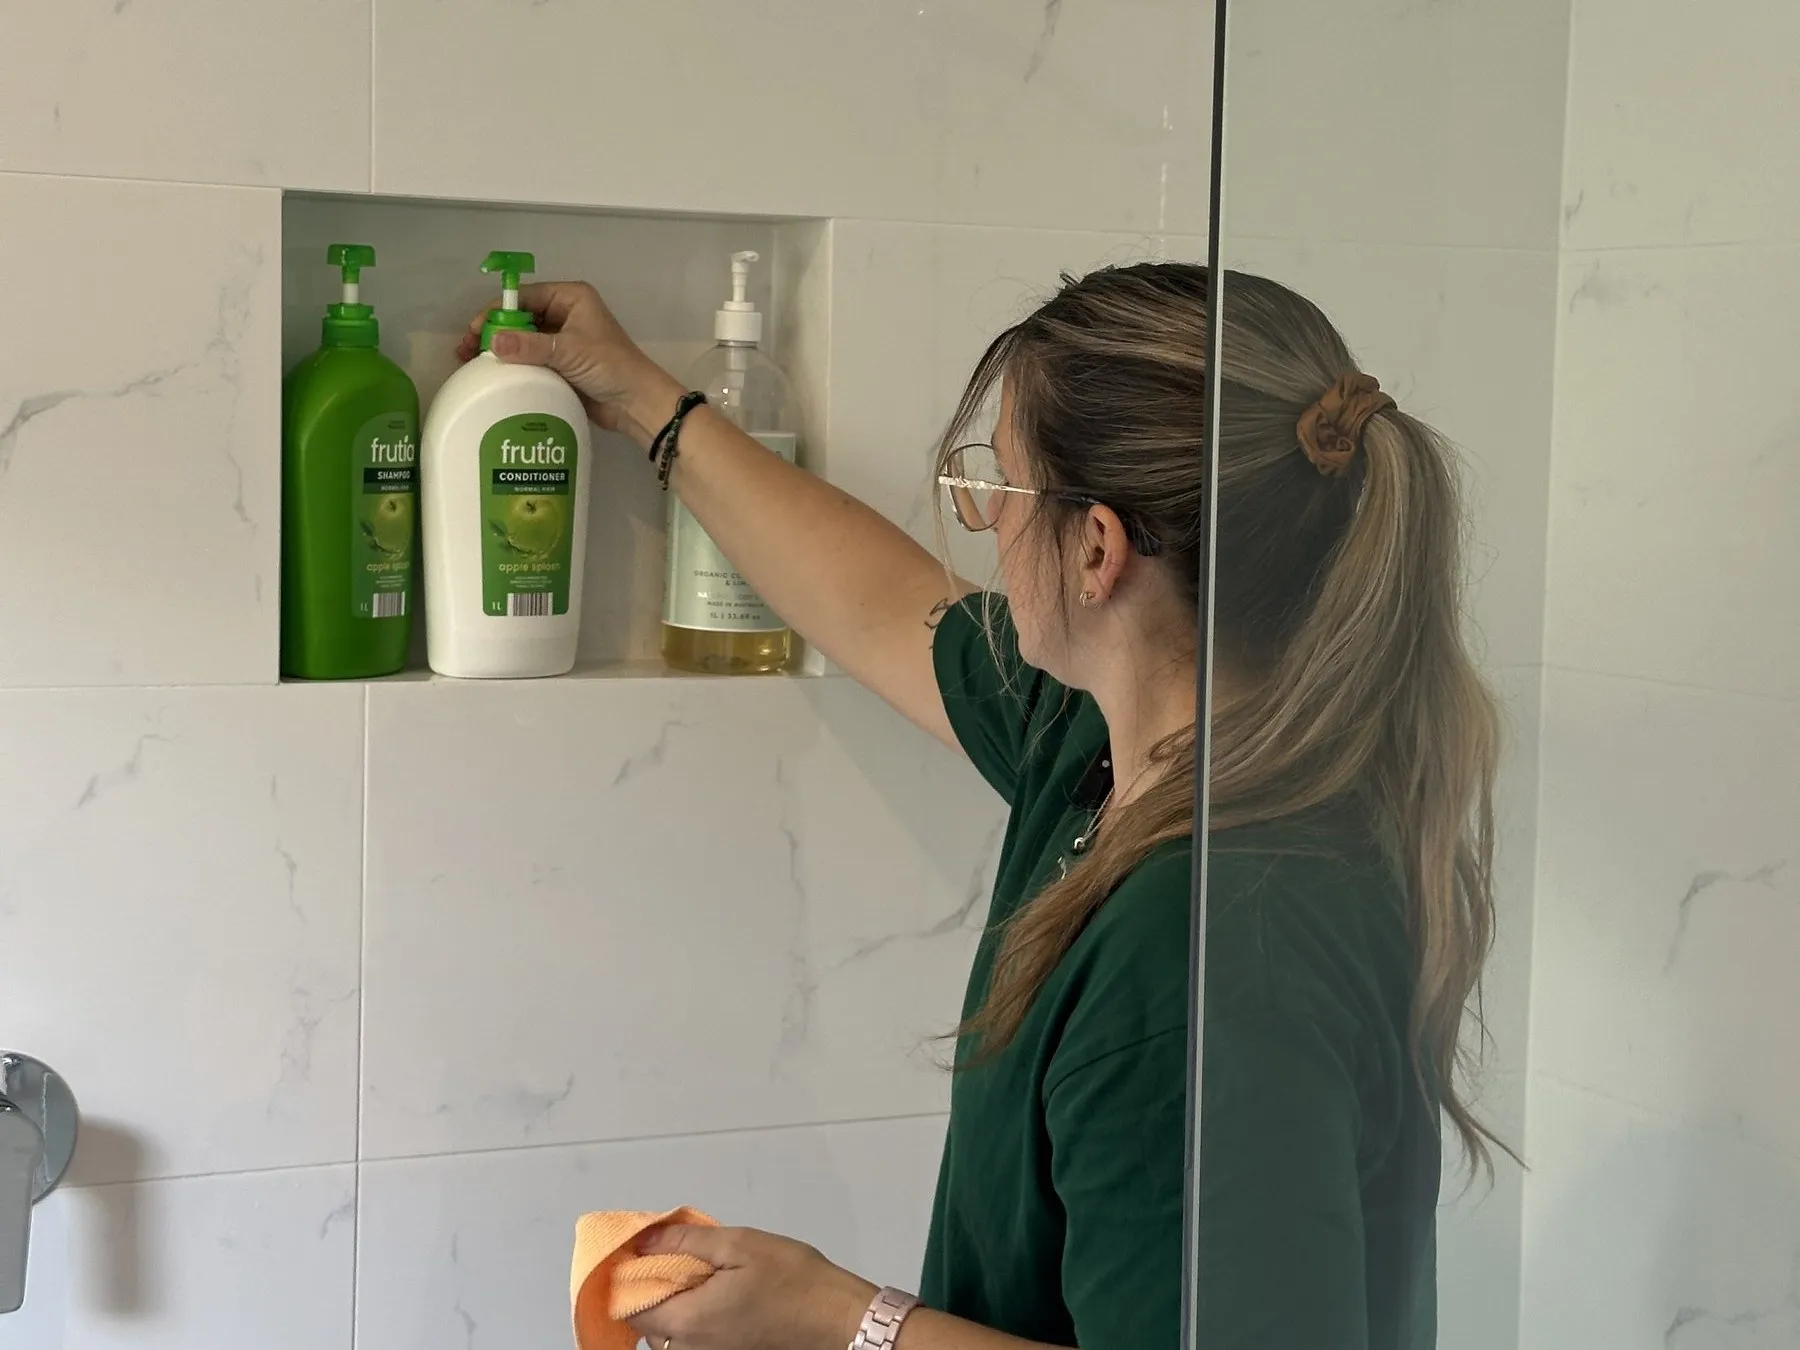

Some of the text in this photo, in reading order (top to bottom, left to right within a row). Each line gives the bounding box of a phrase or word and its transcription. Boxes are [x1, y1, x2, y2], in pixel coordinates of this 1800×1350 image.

[371, 434, 415, 462] frutia
[501, 437, 565, 464] frutia
[377, 470, 411, 480] SHAMPOO
[499, 472, 566, 481] CONDITIONER
[366, 563, 391, 574] apple
[498, 561, 562, 574] apple splash
[693, 570, 728, 579] ORGANIC
[492, 601, 502, 610] 1L
